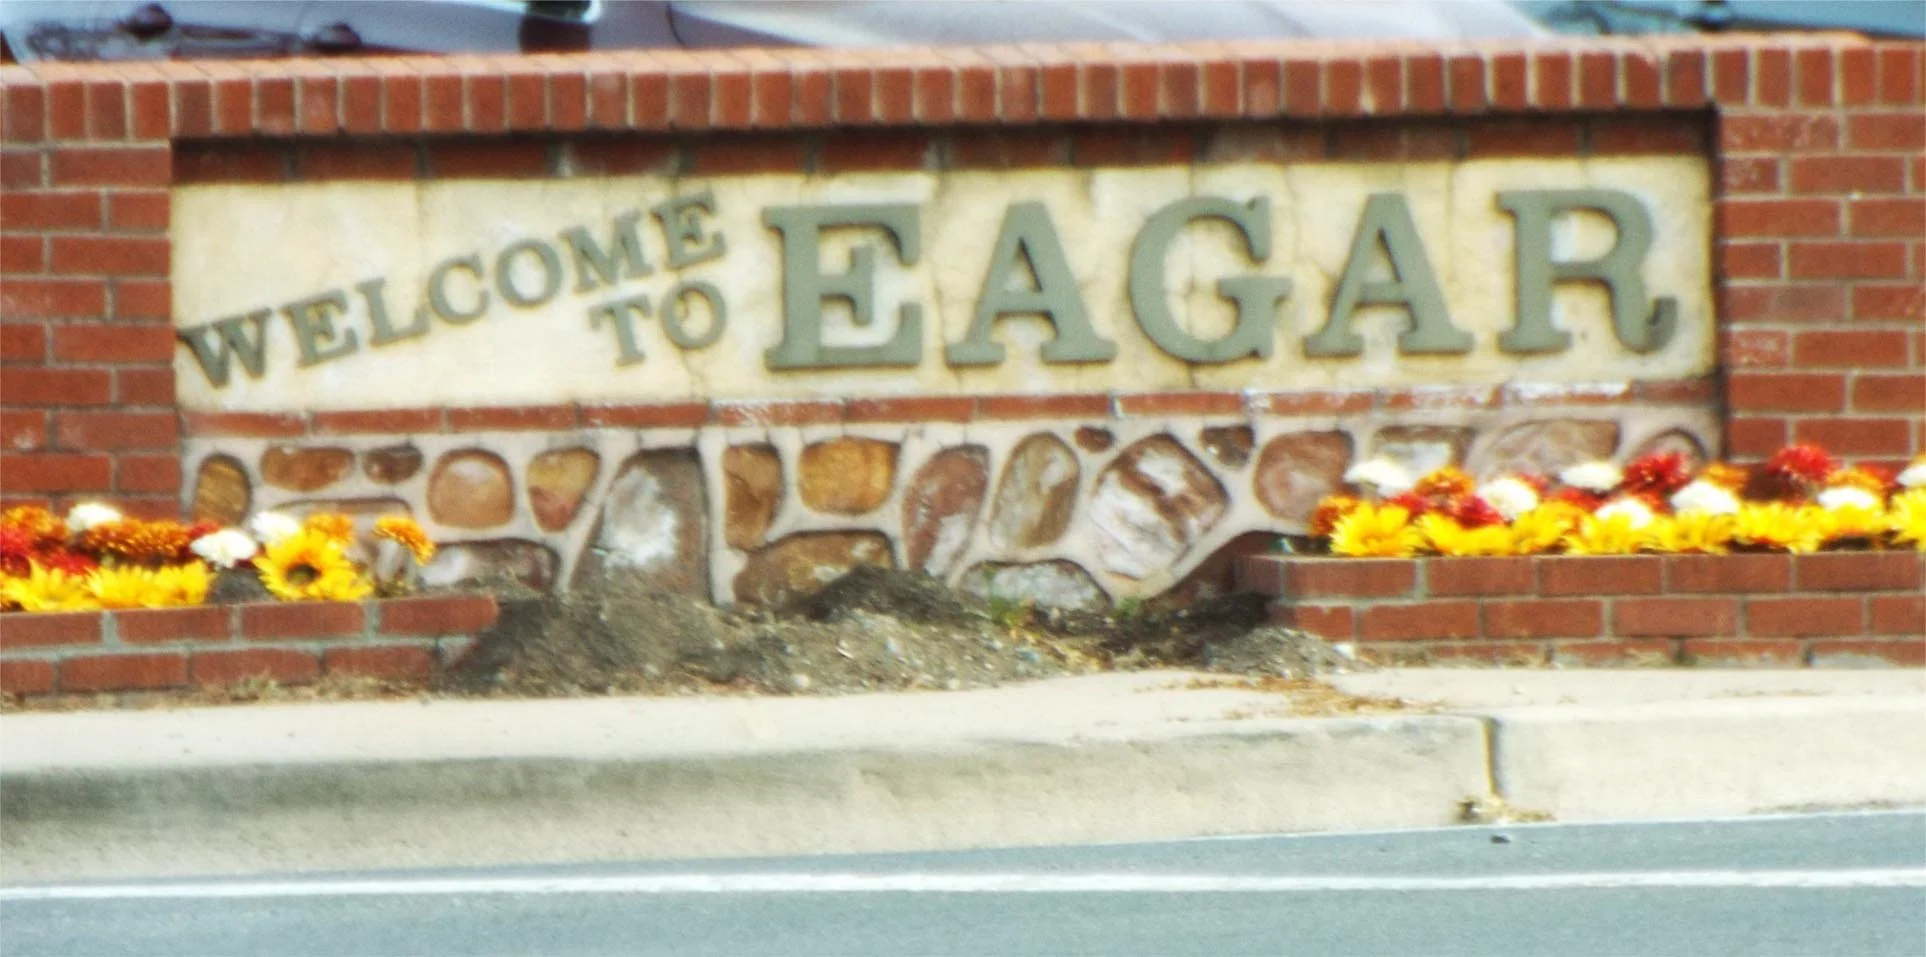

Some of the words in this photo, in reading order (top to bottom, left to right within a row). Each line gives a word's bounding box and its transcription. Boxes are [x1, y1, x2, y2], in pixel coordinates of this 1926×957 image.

[177, 190, 728, 390] WELCOME
[590, 279, 728, 367] TO
[762, 189, 1678, 371] EAGAR
